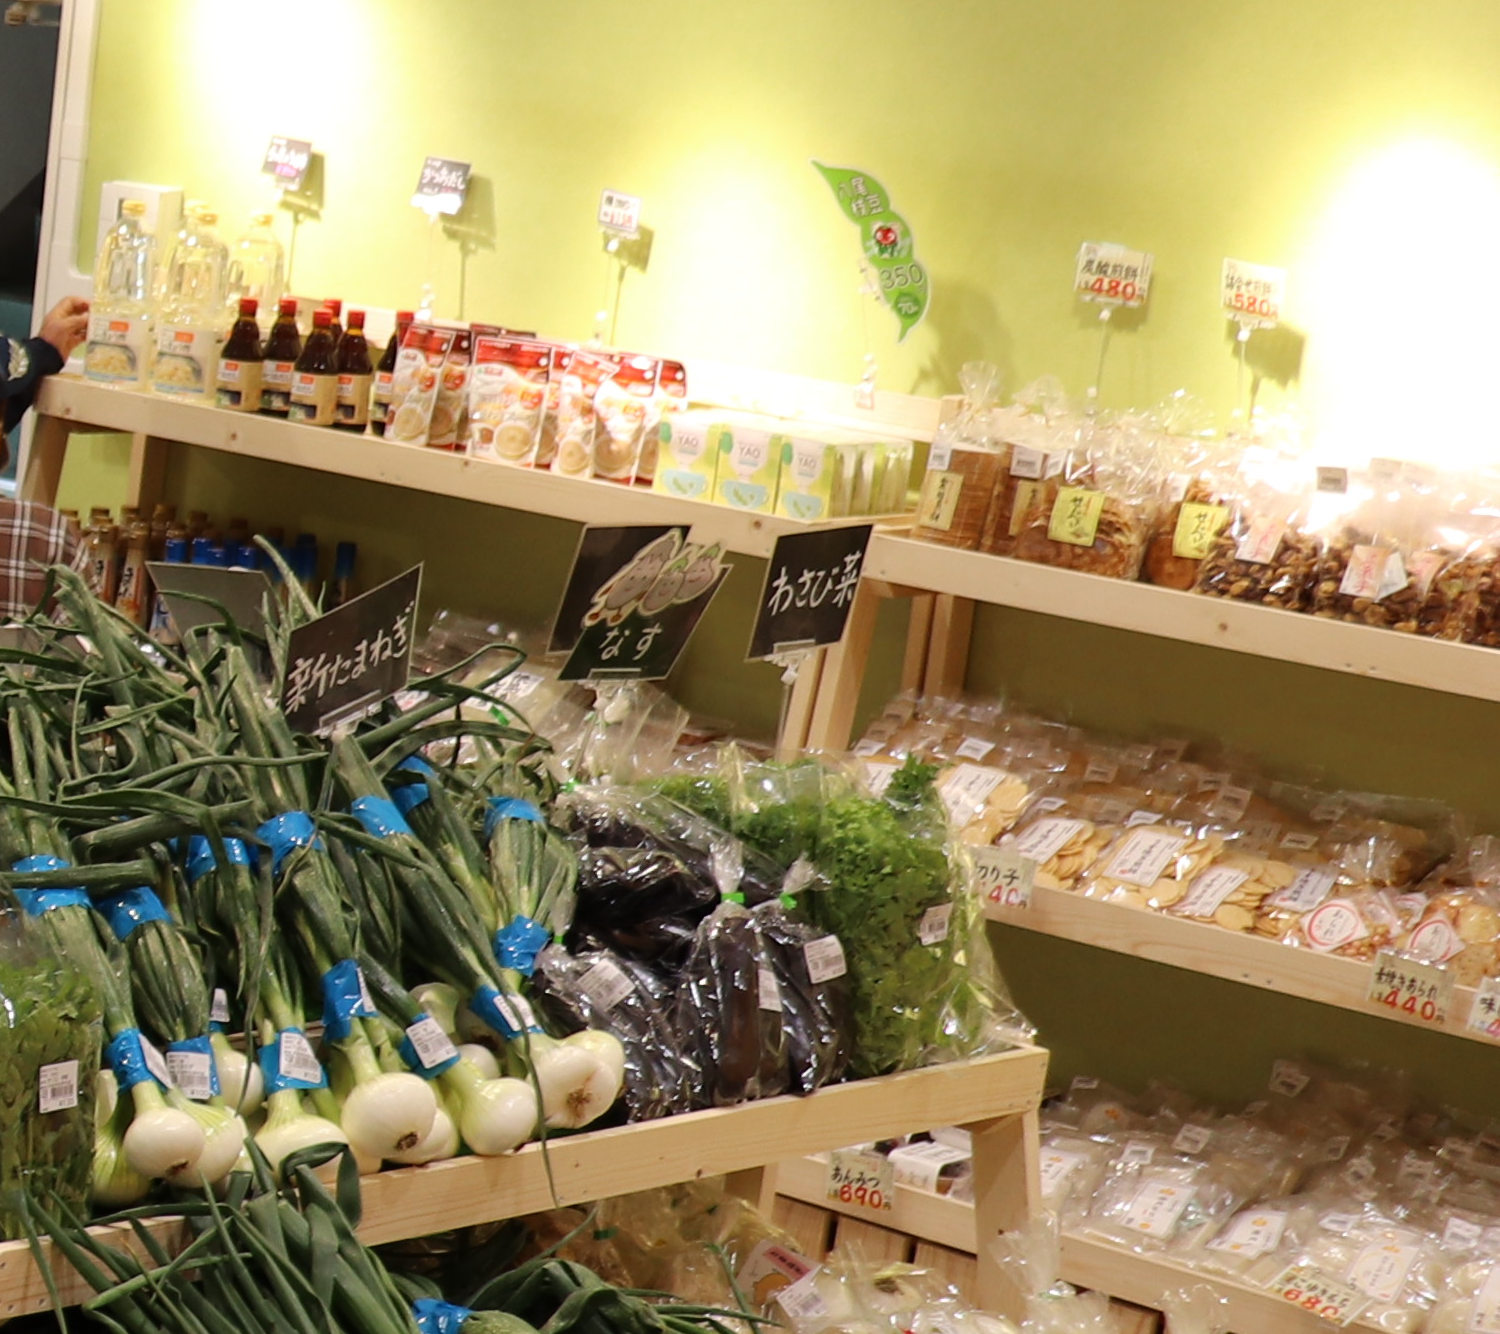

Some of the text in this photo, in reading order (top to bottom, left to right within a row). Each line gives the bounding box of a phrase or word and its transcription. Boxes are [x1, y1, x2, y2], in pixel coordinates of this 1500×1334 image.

[739, 445, 761, 459] YAO
[768, 551, 862, 617] わさび菜
[599, 622, 663, 662] なす
